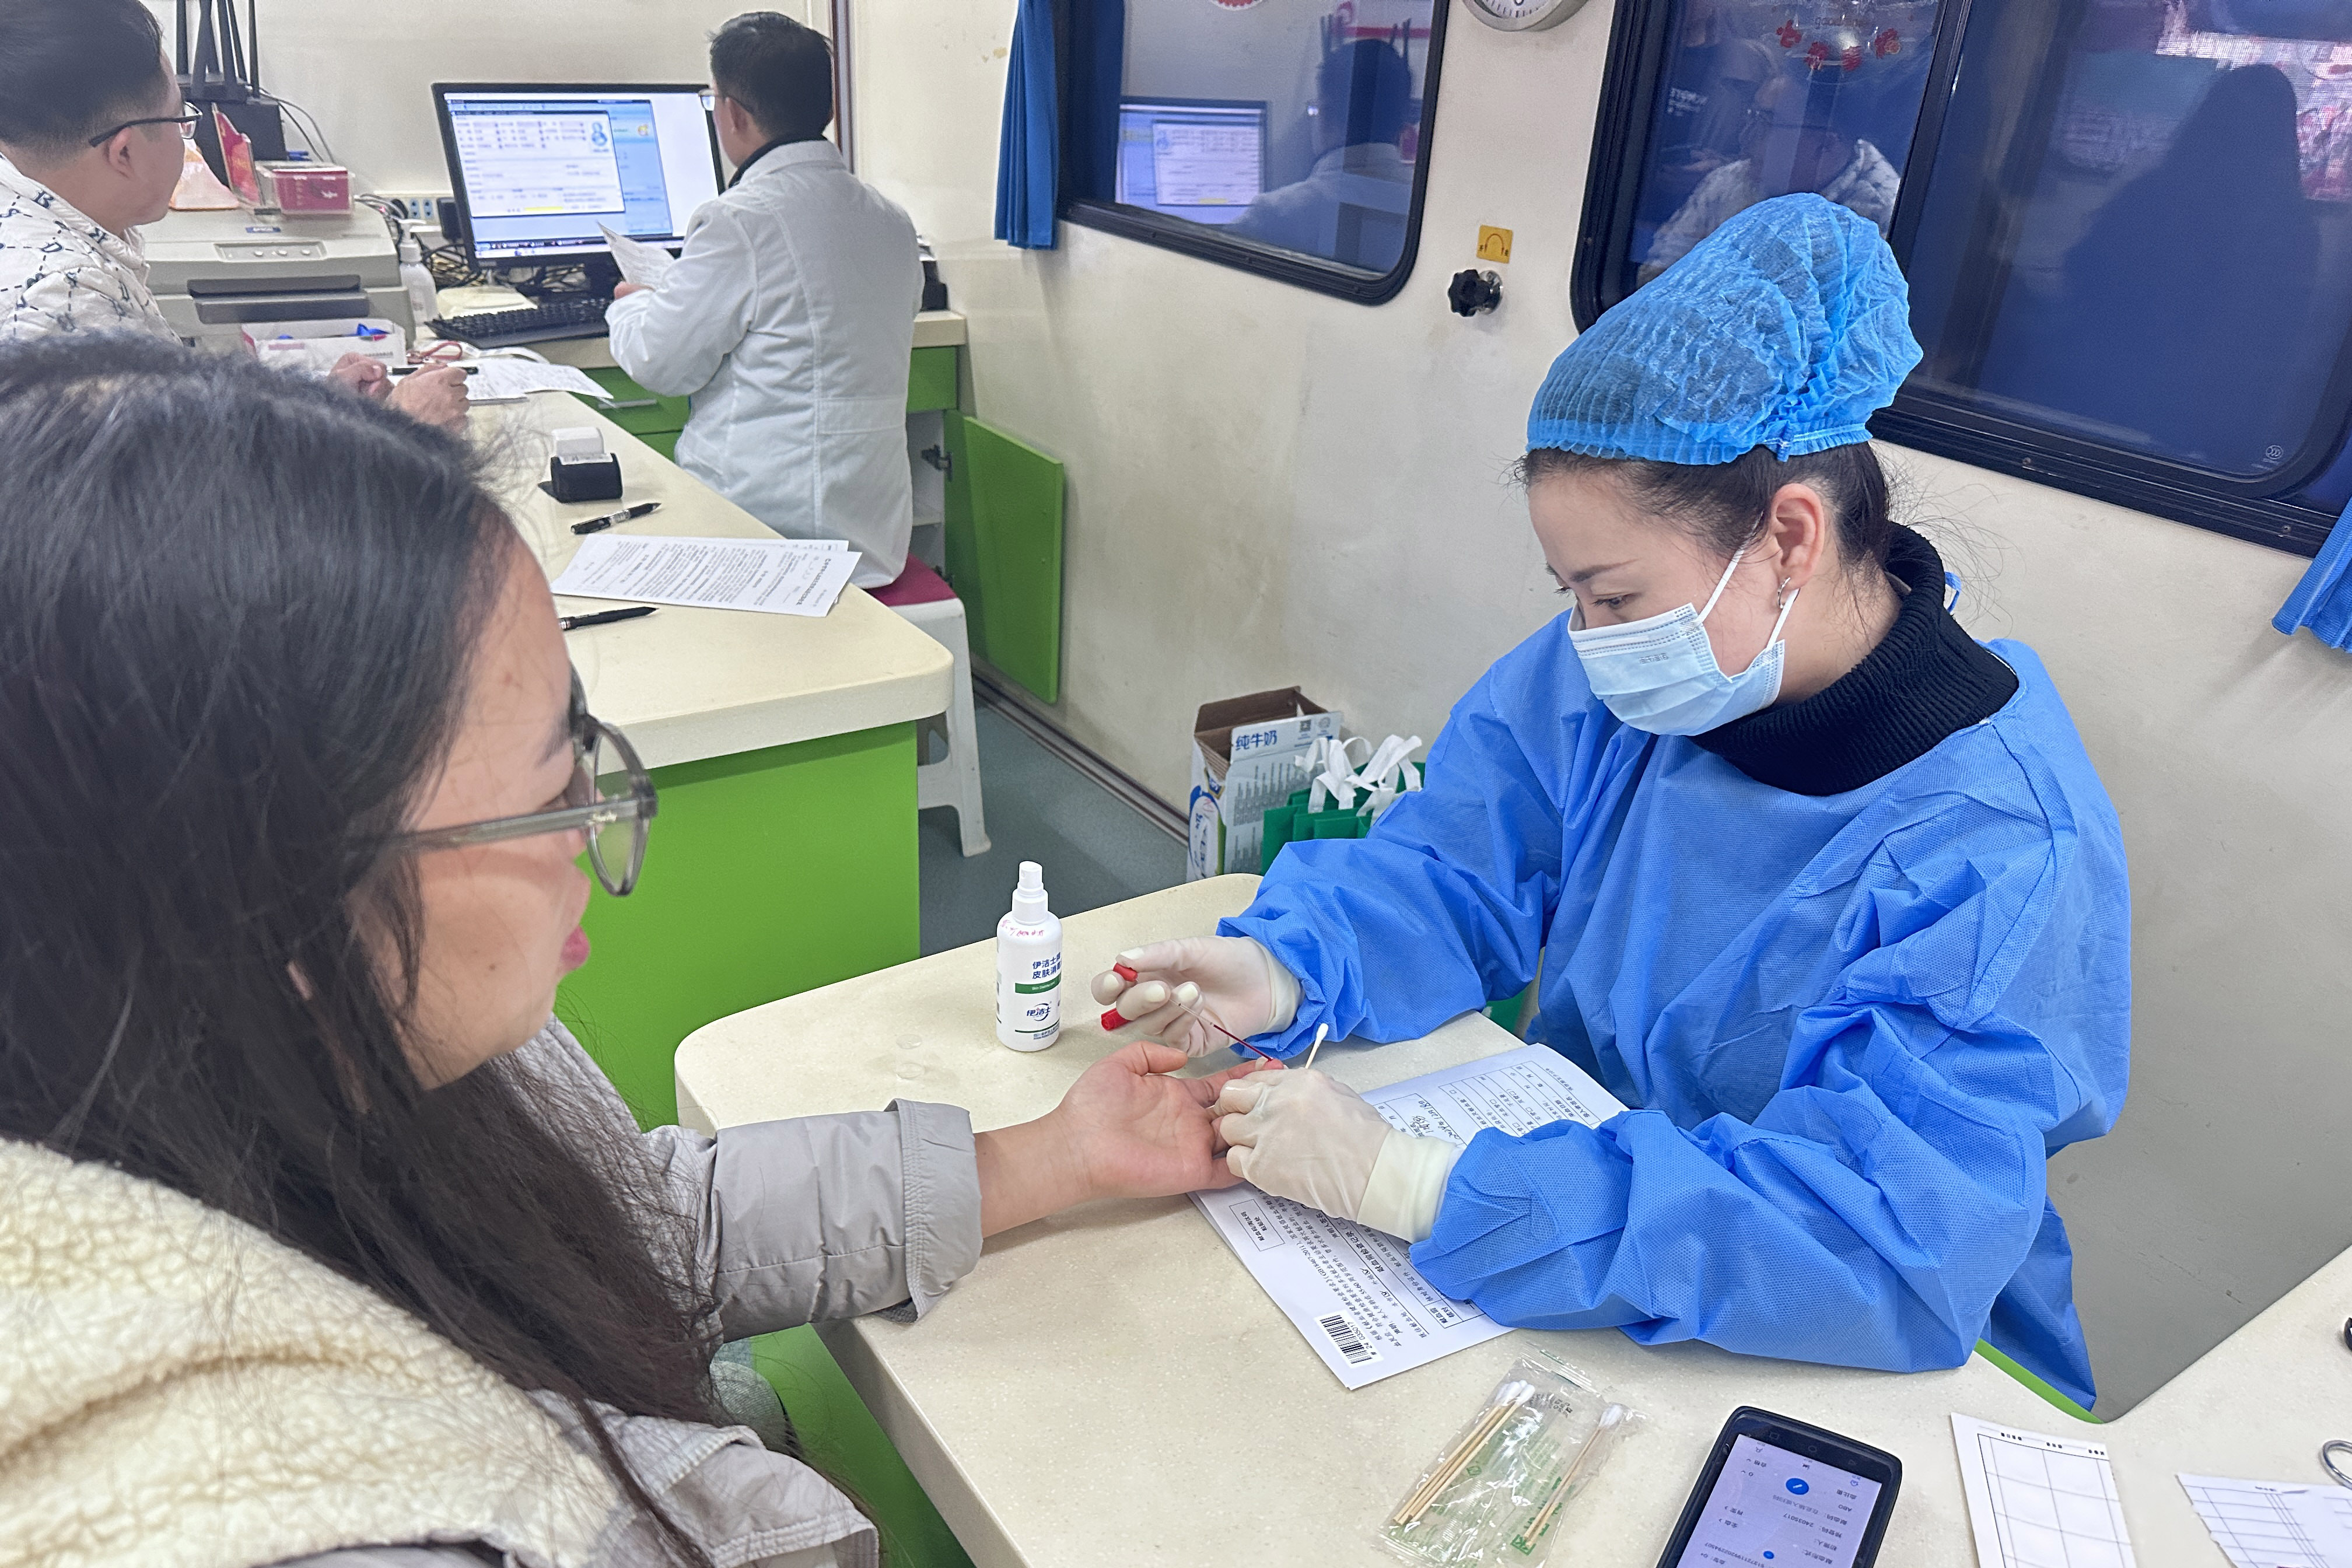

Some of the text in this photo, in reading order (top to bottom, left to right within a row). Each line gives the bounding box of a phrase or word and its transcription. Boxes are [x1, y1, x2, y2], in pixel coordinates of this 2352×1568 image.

[1235, 730, 1278, 751] 纯牛奶
[1346, 1320, 1366, 1340] 035017
[1838, 1504, 1852, 1512] ABO
[1783, 1513, 1814, 1527] 24035017
